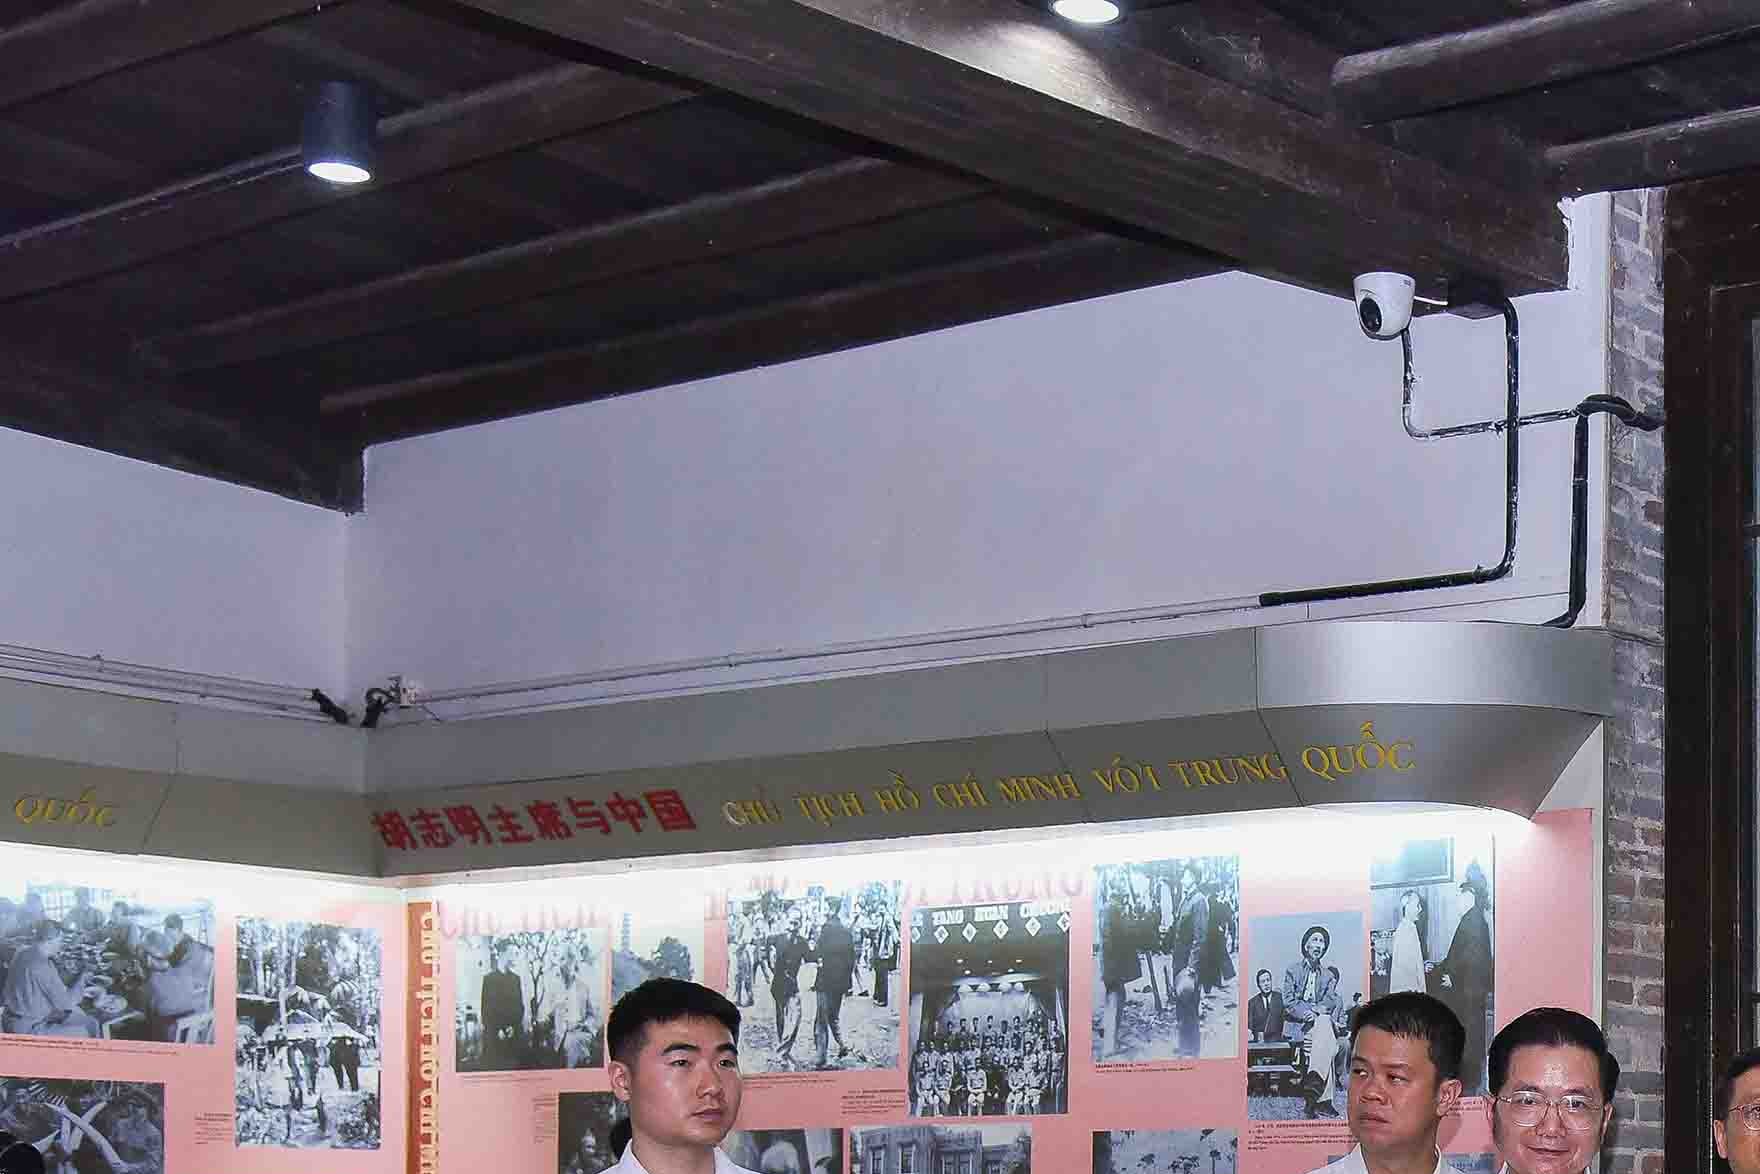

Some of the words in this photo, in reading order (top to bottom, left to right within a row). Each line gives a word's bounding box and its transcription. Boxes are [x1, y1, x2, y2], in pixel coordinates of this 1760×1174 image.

[794, 791, 865, 828] TỊCH
[873, 769, 921, 814] HỒ
[931, 771, 992, 808] CHÍ
[996, 771, 1082, 806] MINH
[1092, 753, 1161, 793] VỚI
[1167, 752, 1290, 788] TRUNG
[1302, 720, 1417, 783] QUỐC
[372, 789, 697, 850] 胡志明主席与中国
